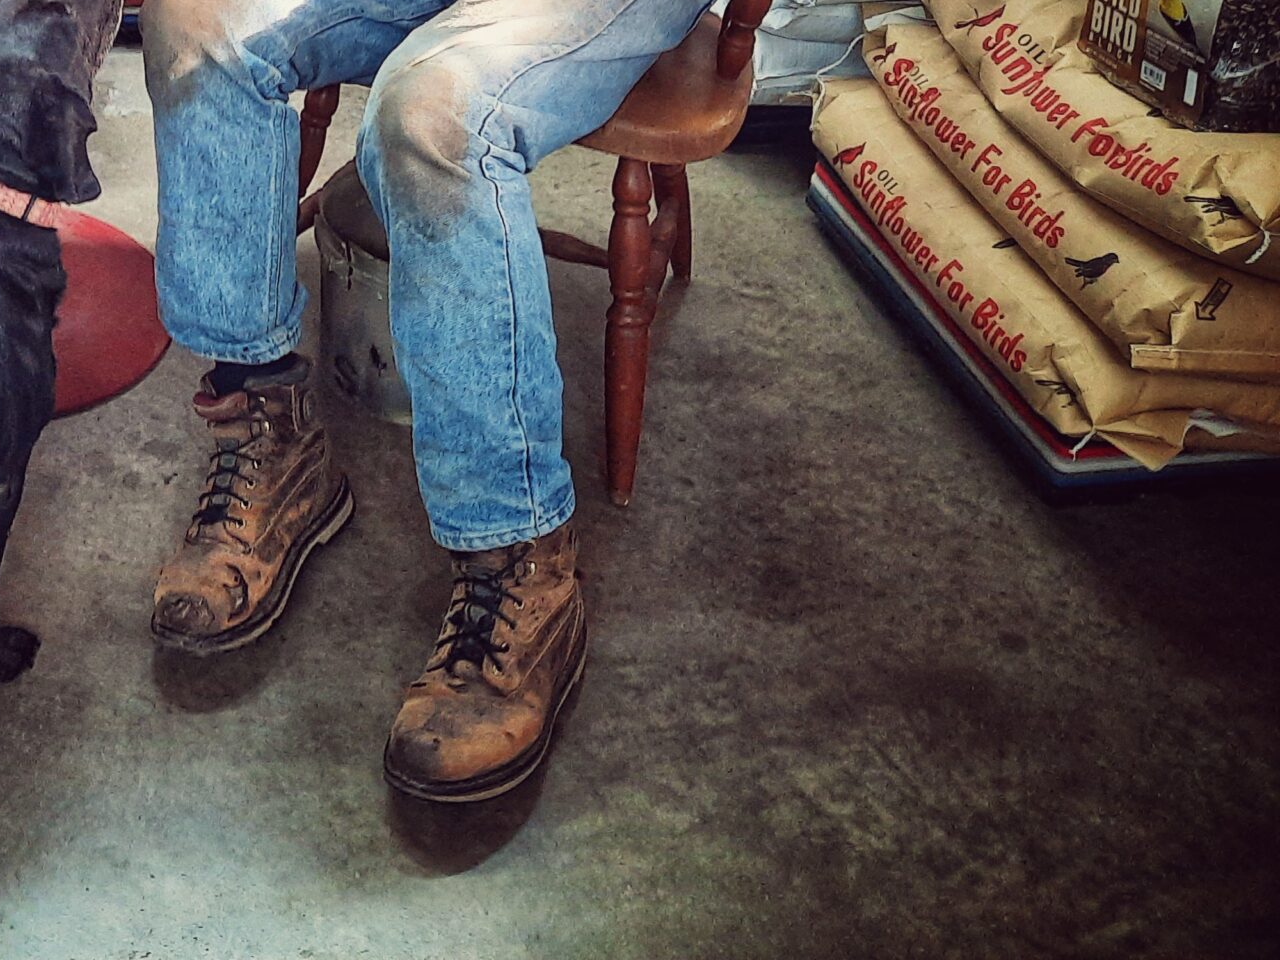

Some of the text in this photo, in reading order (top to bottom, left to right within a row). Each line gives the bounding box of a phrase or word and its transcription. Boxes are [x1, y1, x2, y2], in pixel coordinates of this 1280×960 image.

[1018, 33, 1048, 65] OIL
[877, 169, 899, 196] OIL
[971, 143, 1013, 195] For
[1006, 178, 1065, 249] Birds
[853, 160, 1028, 373] Sunflower For Birds
